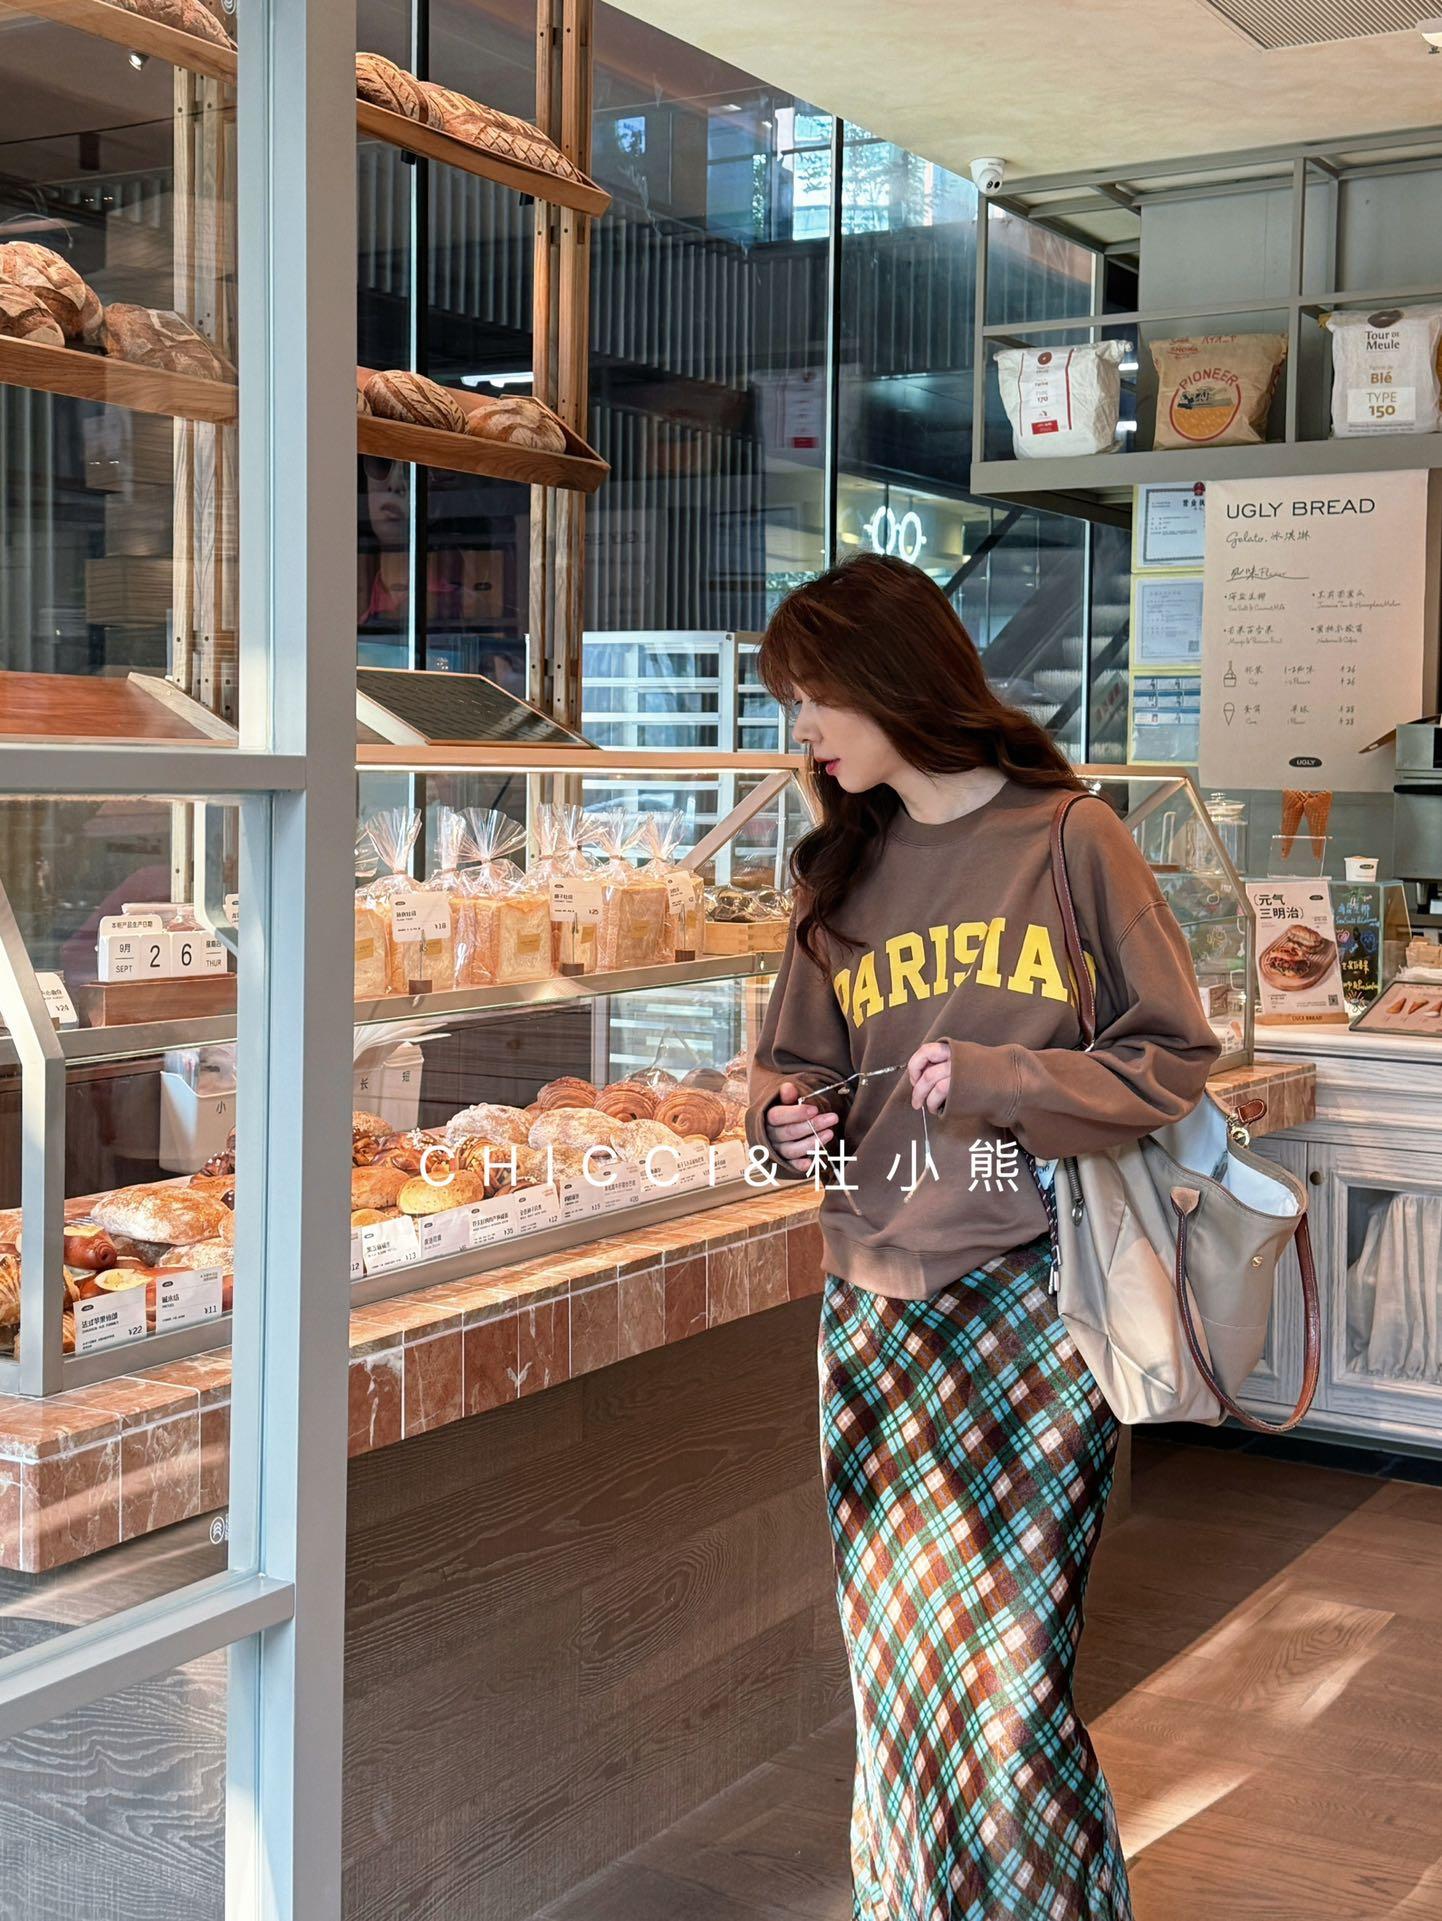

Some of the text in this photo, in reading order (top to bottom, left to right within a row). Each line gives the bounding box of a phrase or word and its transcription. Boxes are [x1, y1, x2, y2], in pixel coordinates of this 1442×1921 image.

[1365, 330, 1390, 340] Tour
[1366, 340, 1400, 350] Meule
[1179, 367, 1239, 390] PIONEER
[1370, 371, 1393, 384] Blé
[1368, 391, 1397, 403] TYPE
[1368, 405, 1396, 418] 150
[1226, 498, 1375, 519] UGLY BREAD
[1259, 906, 1304, 919] 三明治)
[119, 943, 131, 953] 9月
[149, 944, 161, 968] 2
[181, 943, 192, 967] 6
[115, 965, 133, 973] SEPT
[206, 959, 222, 967] THUR
[402, 1071, 411, 1083] 短
[360, 1078, 369, 1090] 长
[216, 1101, 226, 1114] 小
[204, 1305, 217, 1314] ¥11
[128, 1325, 143, 1336] ¥22
